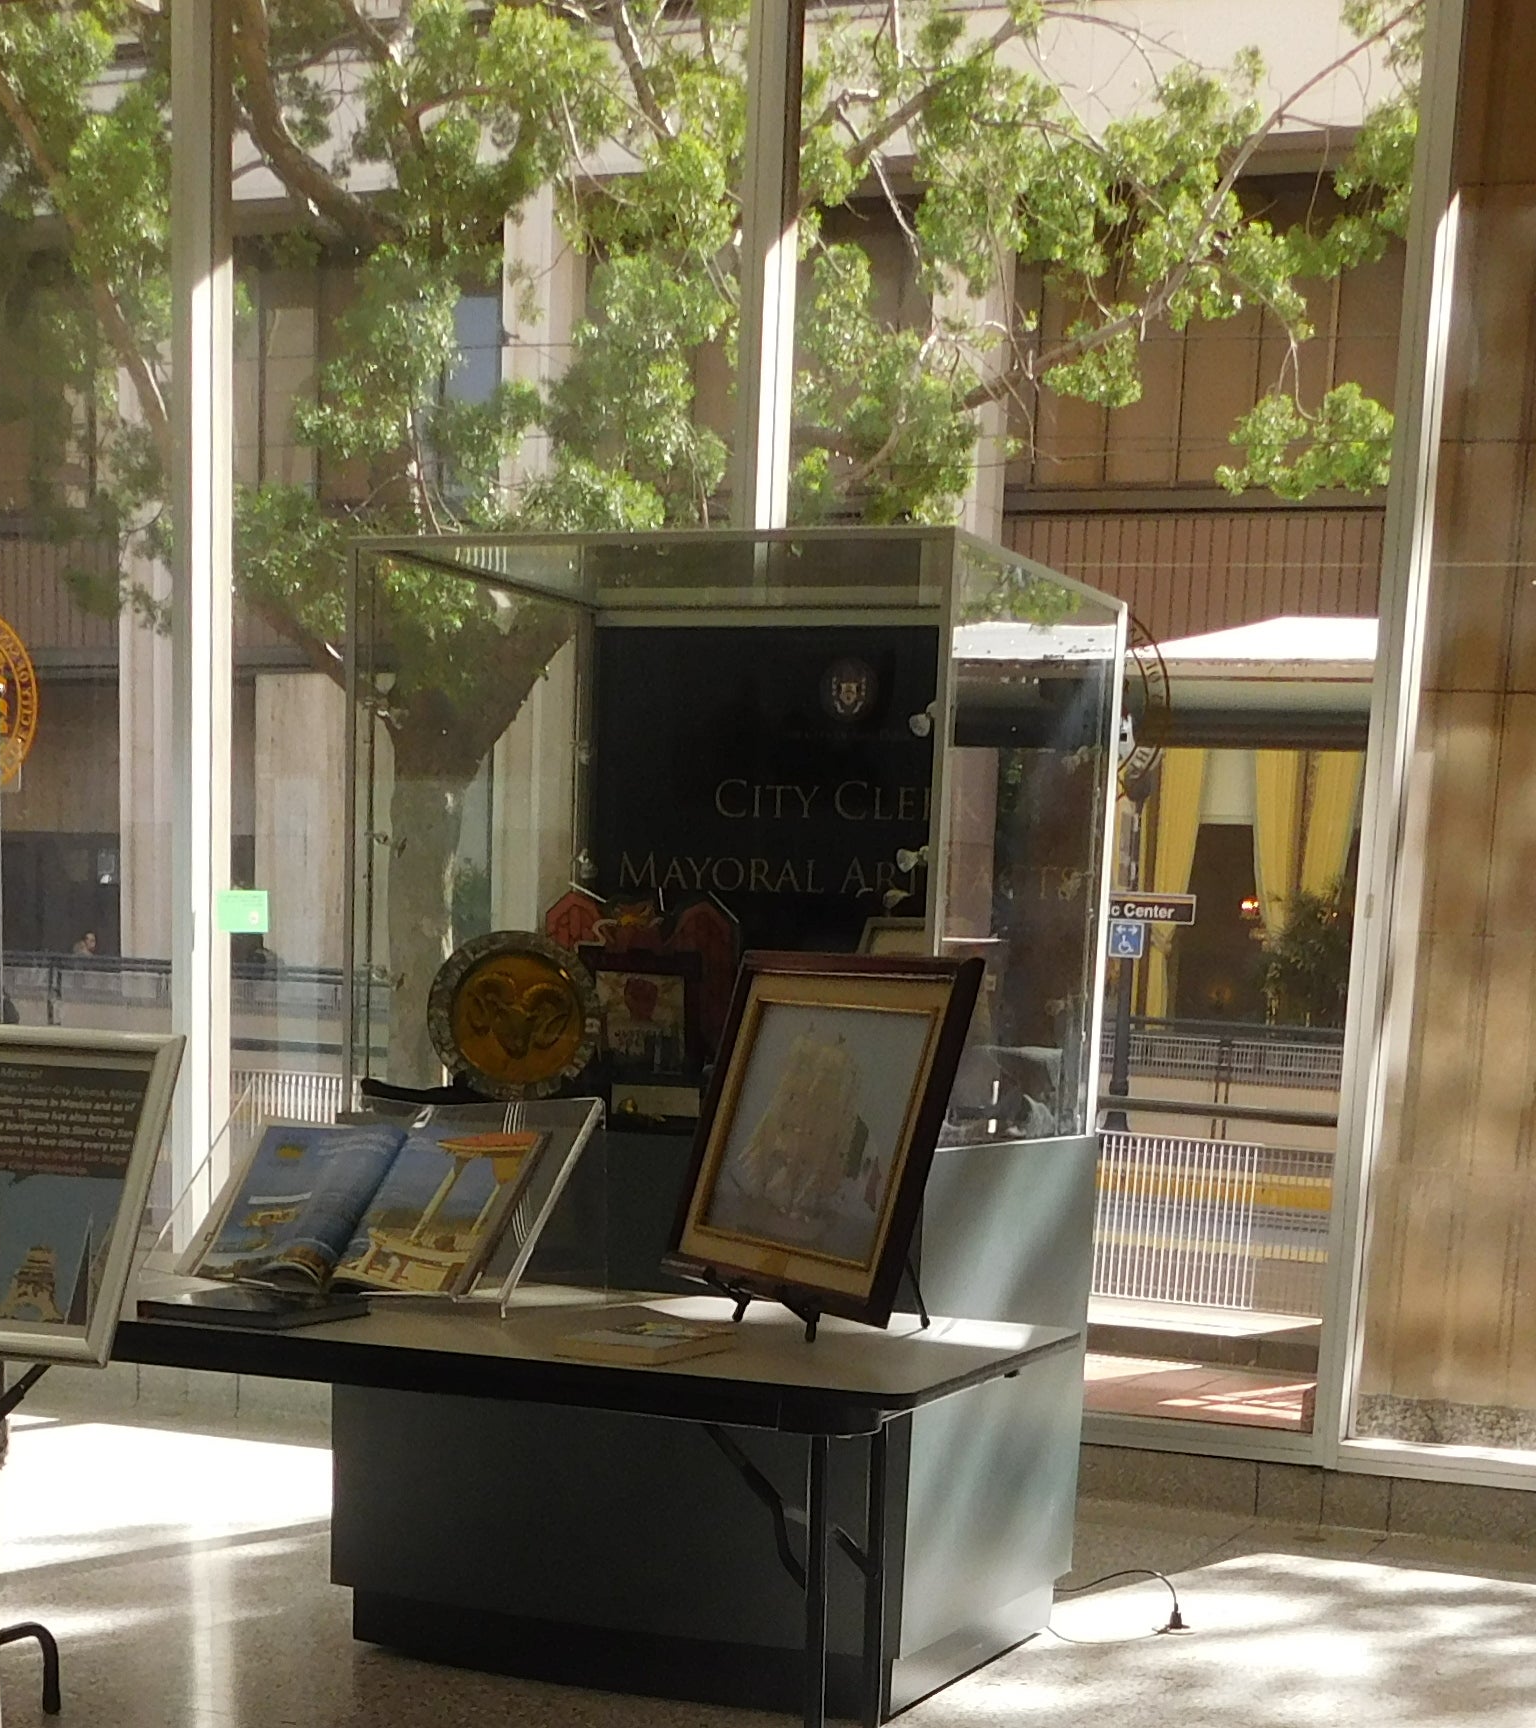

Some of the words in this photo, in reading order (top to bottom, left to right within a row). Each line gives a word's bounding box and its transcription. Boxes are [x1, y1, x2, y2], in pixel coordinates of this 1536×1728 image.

[713, 778, 823, 821] CITY
[618, 851, 825, 895] MAYORAL
[1124, 903, 1175, 919] Center
